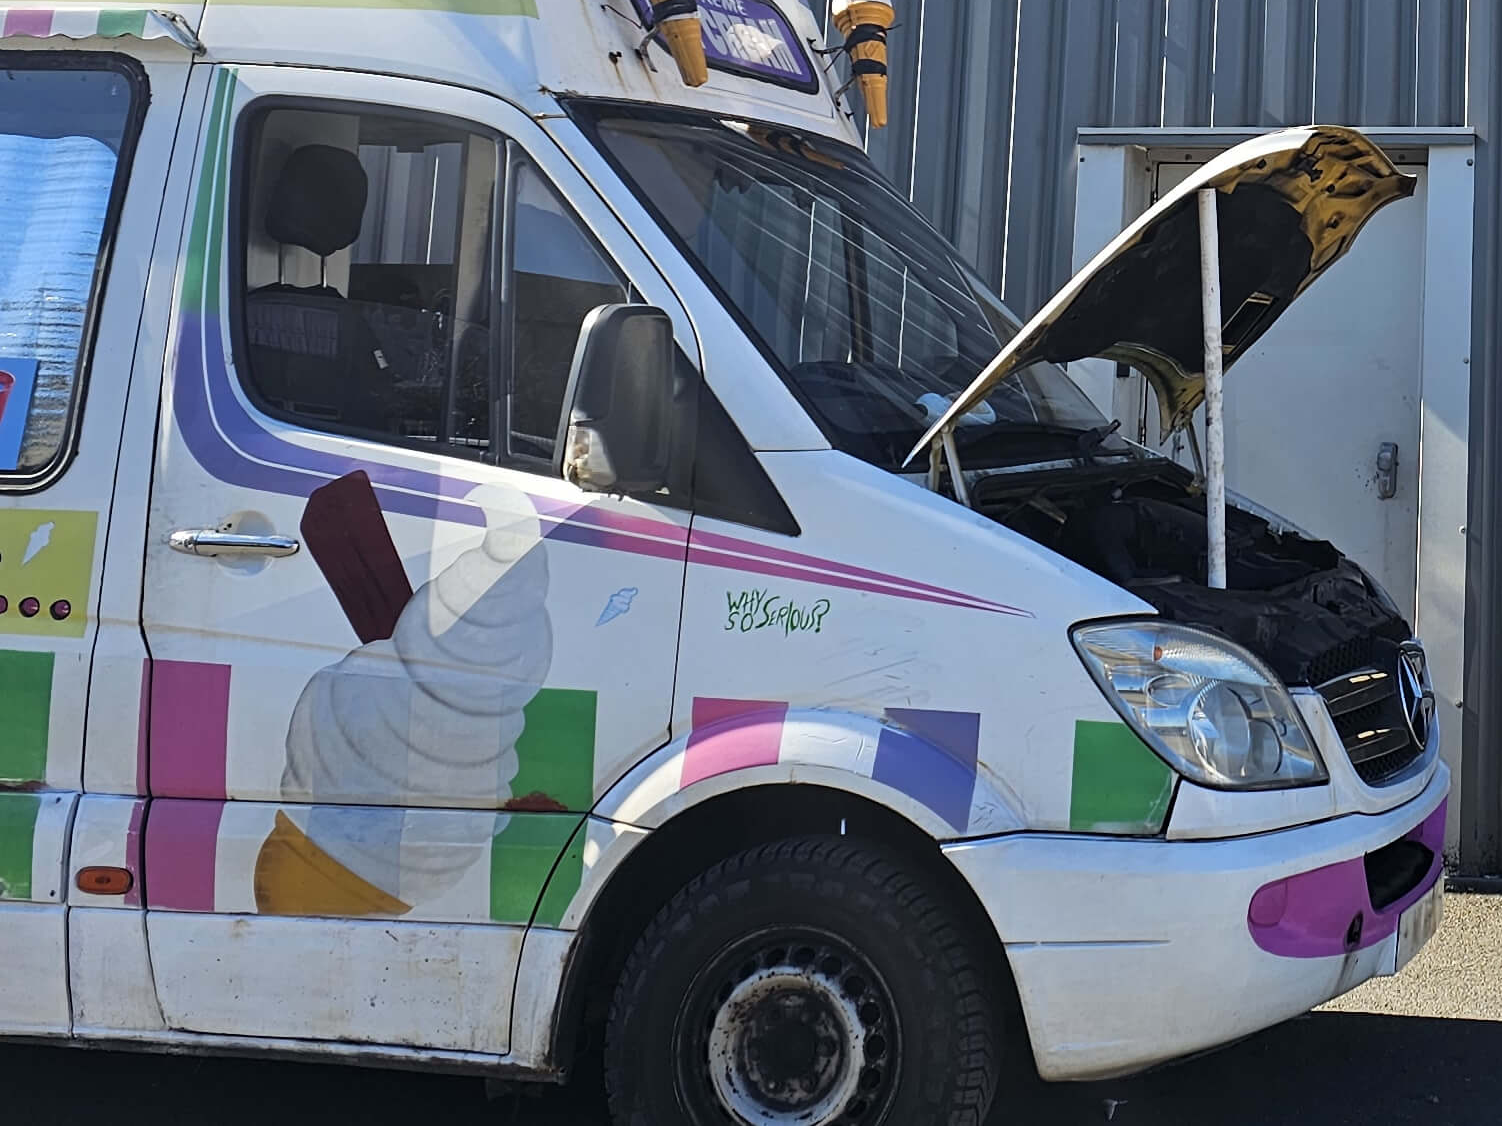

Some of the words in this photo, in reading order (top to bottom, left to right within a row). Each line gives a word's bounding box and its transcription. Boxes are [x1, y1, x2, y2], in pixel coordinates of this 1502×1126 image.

[724, 610, 754, 632] SO
[755, 595, 830, 638] SERIOUS?
[726, 588, 768, 615] WHY
